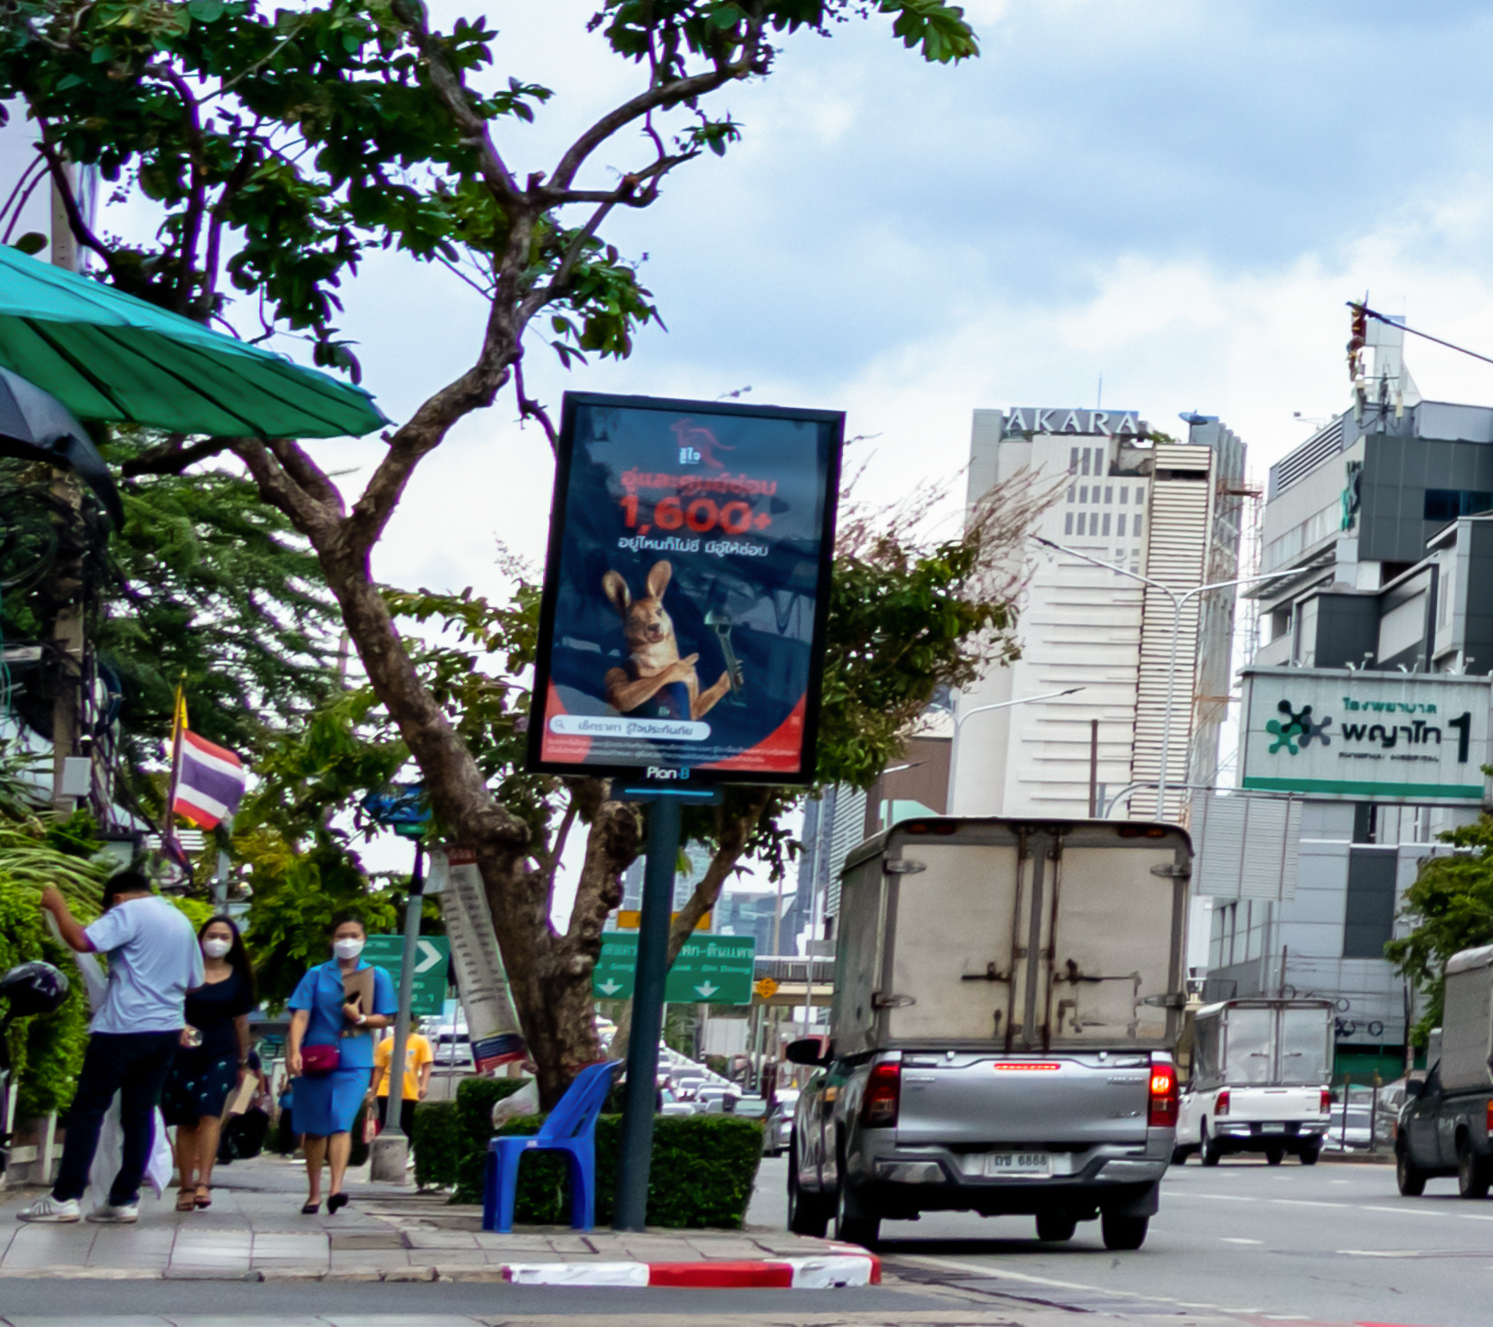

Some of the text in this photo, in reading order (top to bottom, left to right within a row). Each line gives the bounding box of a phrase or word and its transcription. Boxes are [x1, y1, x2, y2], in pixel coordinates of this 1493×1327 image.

[1004, 407, 1139, 436] AKARA
[620, 495, 773, 535] 1,600+
[1342, 696, 1438, 714] โรงพยาบาล
[1340, 711, 1472, 764] พญาไท 1
